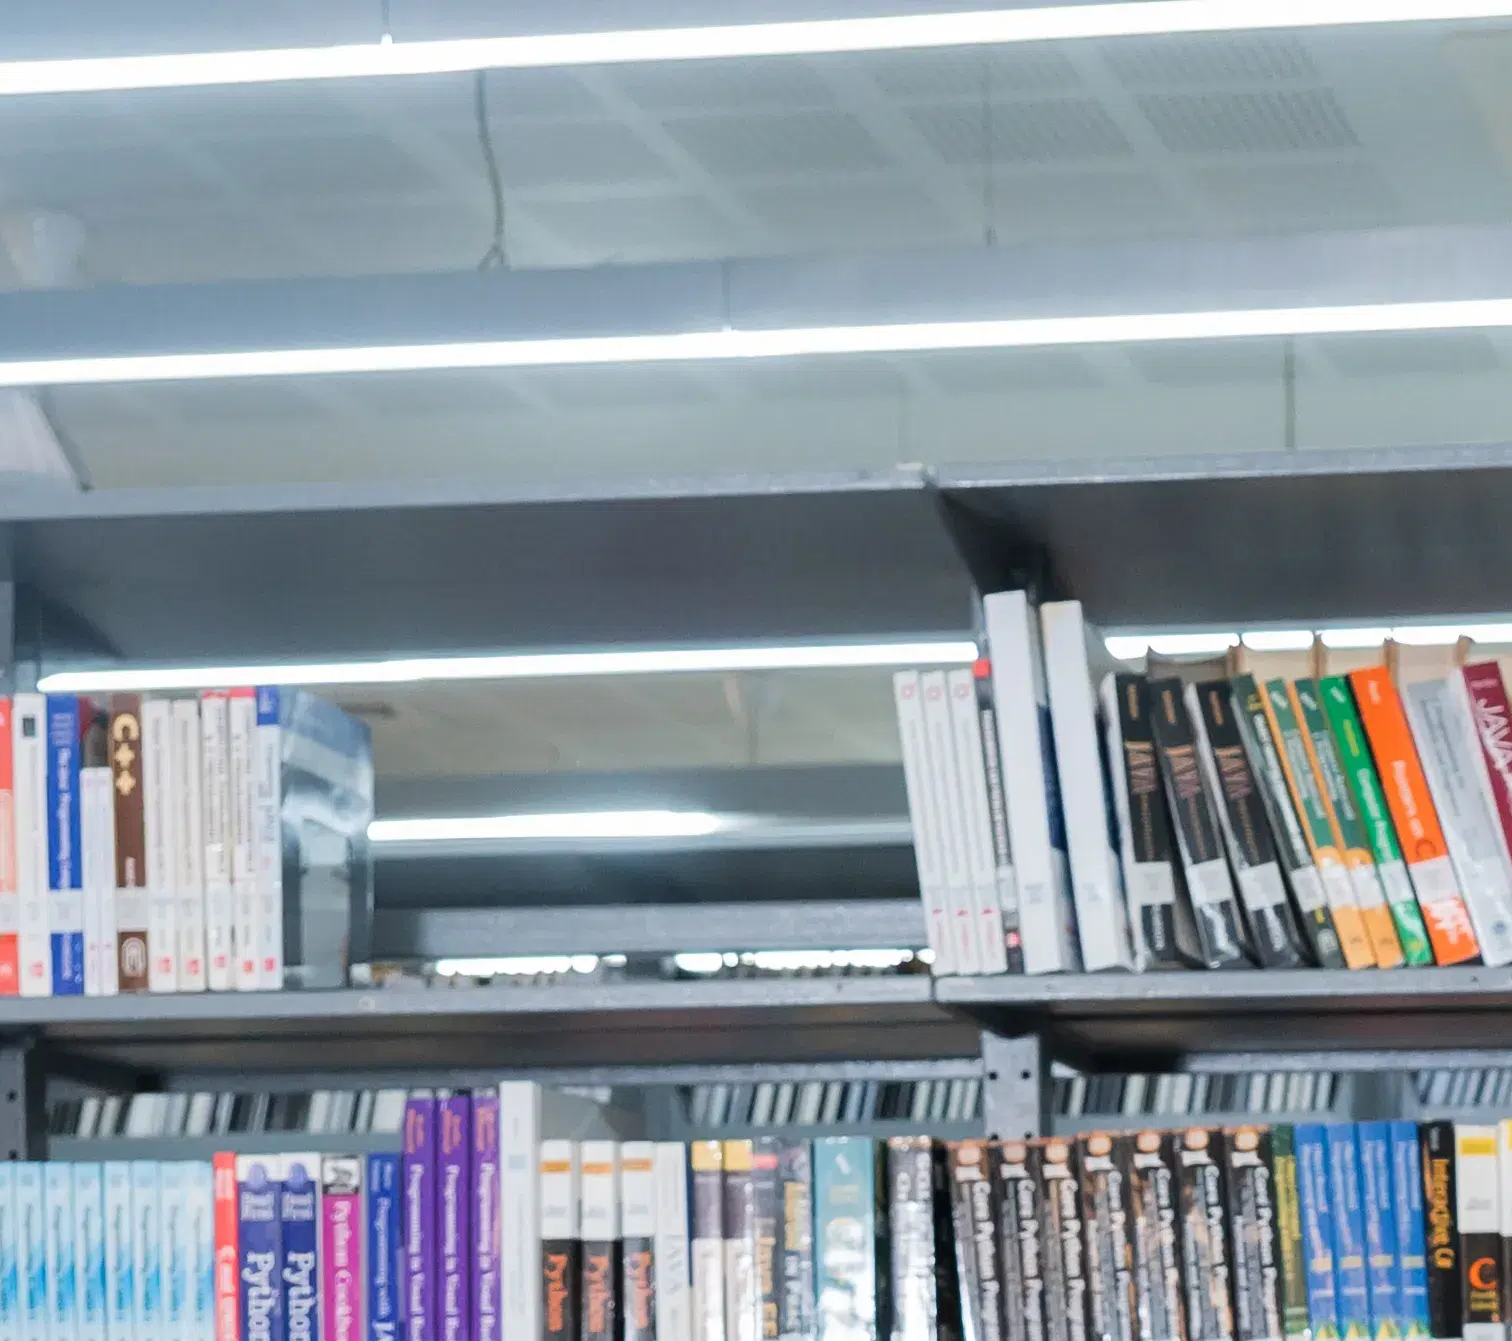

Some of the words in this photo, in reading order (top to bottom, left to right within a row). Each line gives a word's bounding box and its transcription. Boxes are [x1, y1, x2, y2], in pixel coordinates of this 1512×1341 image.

[112, 713, 138, 795] C++
[1125, 741, 1154, 793] JAVA
[1166, 747, 1199, 795] JAVA
[1216, 745, 1253, 797] JAVA
[1432, 1158, 1451, 1243] Interactive
[546, 1253, 568, 1331] Python
[588, 1253, 609, 1331] Python
[633, 1253, 652, 1327] Python
